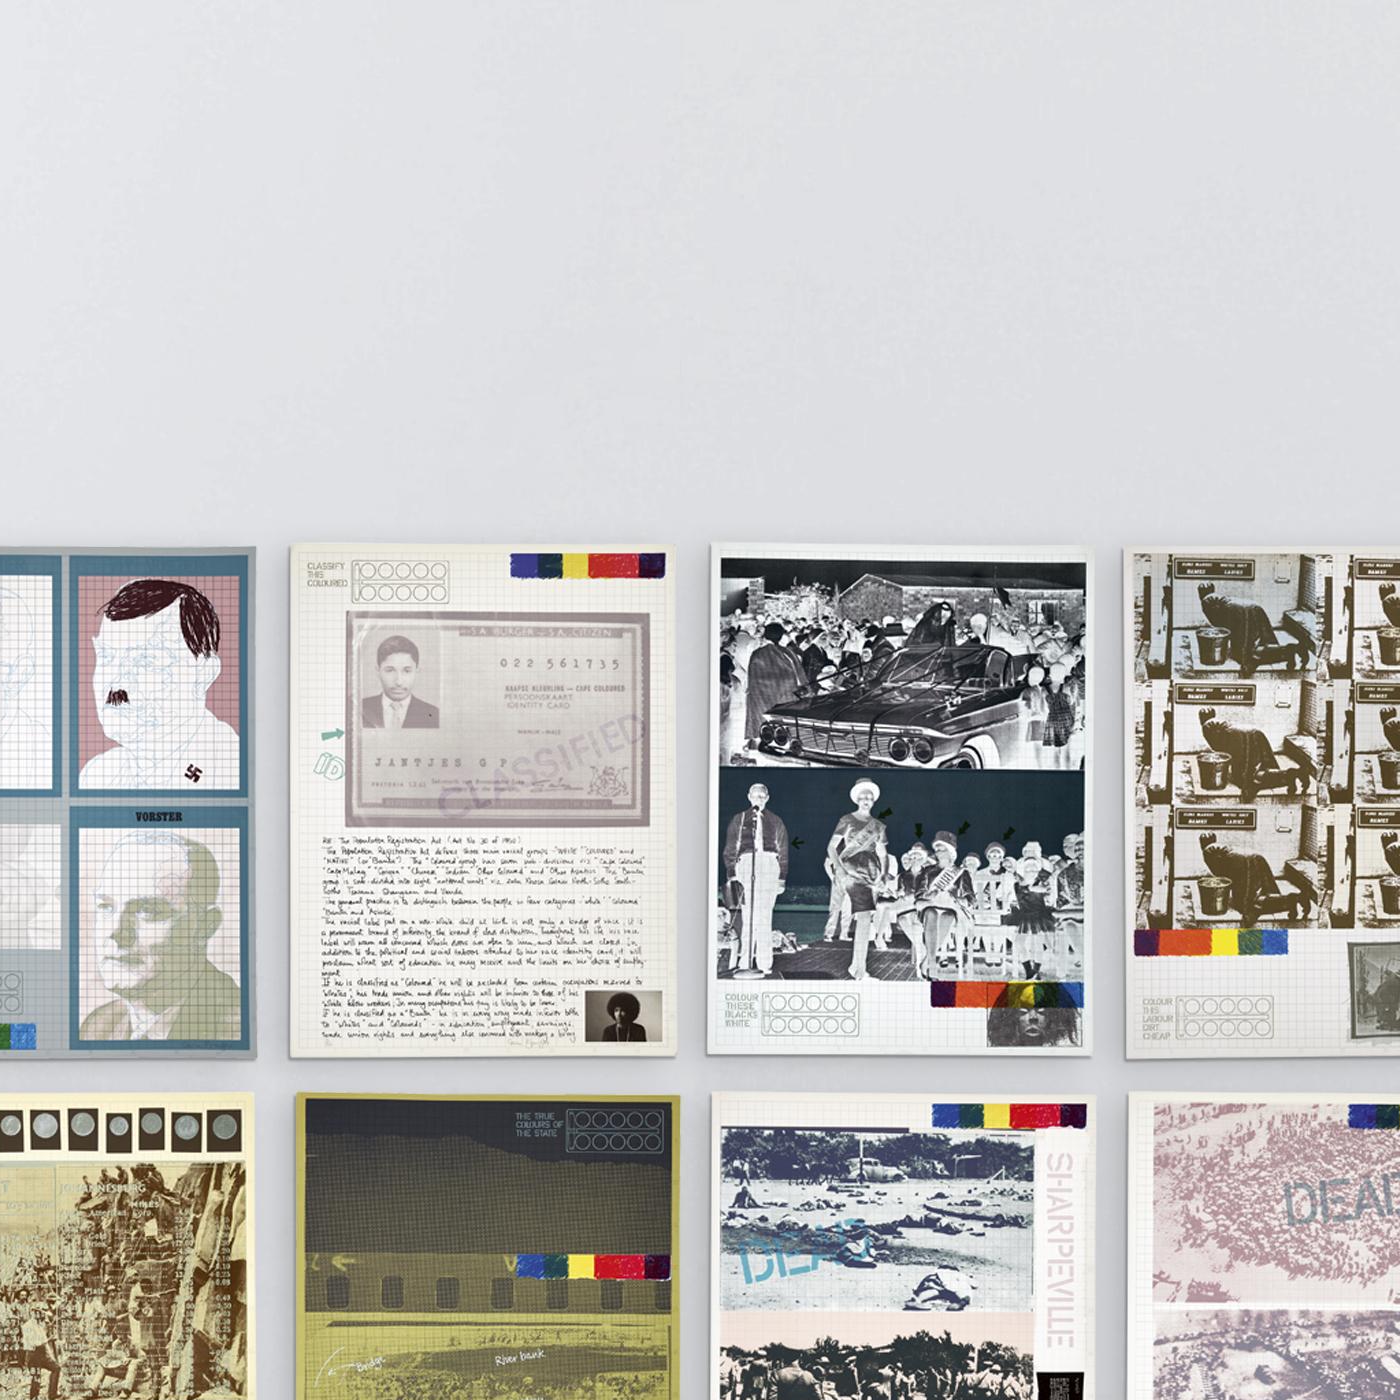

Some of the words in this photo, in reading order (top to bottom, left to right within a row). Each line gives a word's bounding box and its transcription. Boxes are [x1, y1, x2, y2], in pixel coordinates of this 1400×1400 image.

[307, 562, 345, 570] CLASSIFY
[307, 579, 348, 587] COLOURED
[375, 758, 462, 768] JANTJES
[438, 713, 647, 818] CLASSIFIED
[136, 811, 183, 822] VORSTER
[725, 993, 759, 1001] COLOUR
[726, 1002, 756, 1010] THESE
[1143, 998, 1173, 1006] COLOUR
[1143, 1015, 1173, 1023] LABOUR
[516, 1112, 531, 1120] THE
[535, 1112, 555, 1120] TRUE
[516, 1121, 550, 1129] COLOURS
[516, 1129, 531, 1137] THE
[534, 1129, 557, 1137] STATE
[1046, 1152, 1075, 1348] SHARPEVILLE
[494, 1354, 517, 1367] River
[519, 1348, 546, 1362] bank
